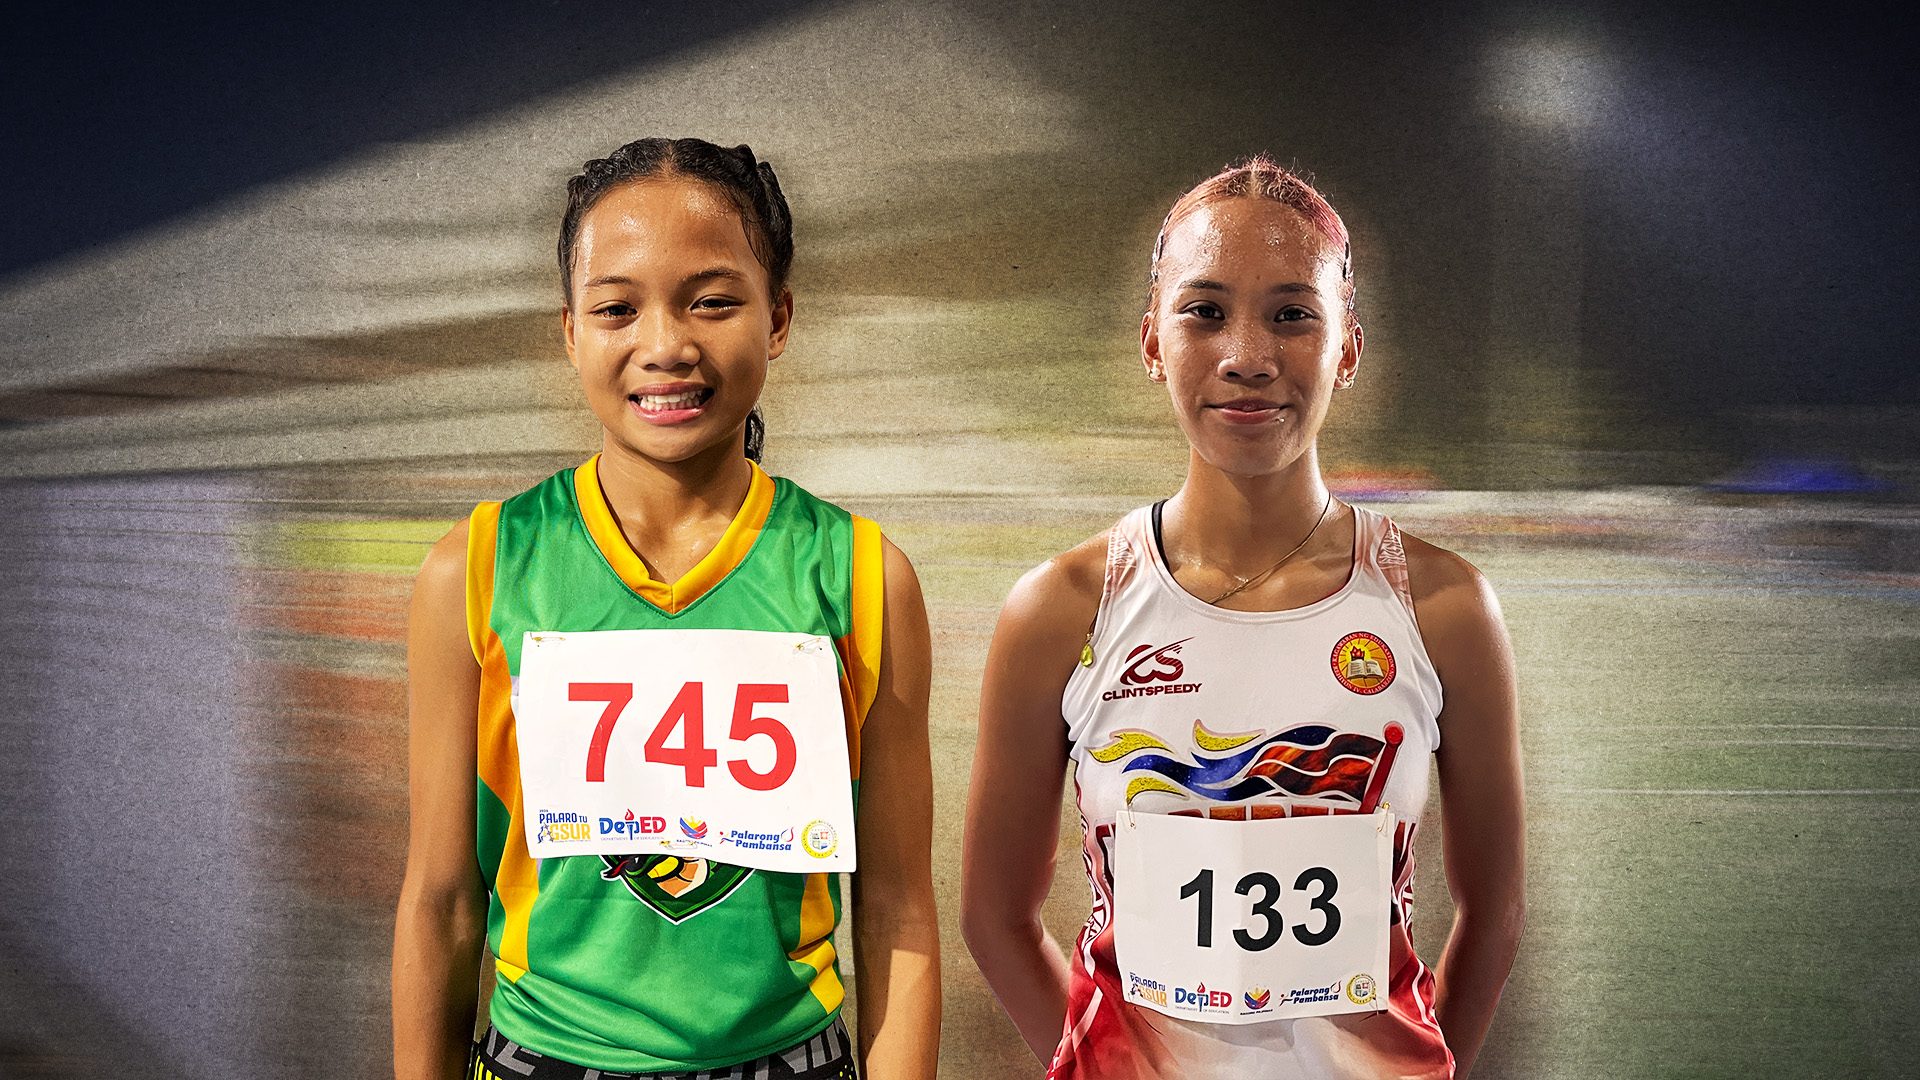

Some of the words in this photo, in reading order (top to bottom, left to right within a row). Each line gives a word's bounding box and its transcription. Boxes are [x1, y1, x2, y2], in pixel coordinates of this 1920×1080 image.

[1102, 683, 1202, 701] CLINTSPEEDY
[568, 681, 797, 791] 745
[539, 812, 577, 824] PALARO
[579, 815, 588, 823] TU
[730, 830, 780, 843] Palarong
[735, 839, 792, 851] Pambansa
[1180, 867, 1341, 951] 133
[1130, 974, 1157, 990] PALARO
[1158, 983, 1166, 992] TU
[1290, 987, 1330, 998] Palarong
[1293, 993, 1339, 1004] Pambansa
